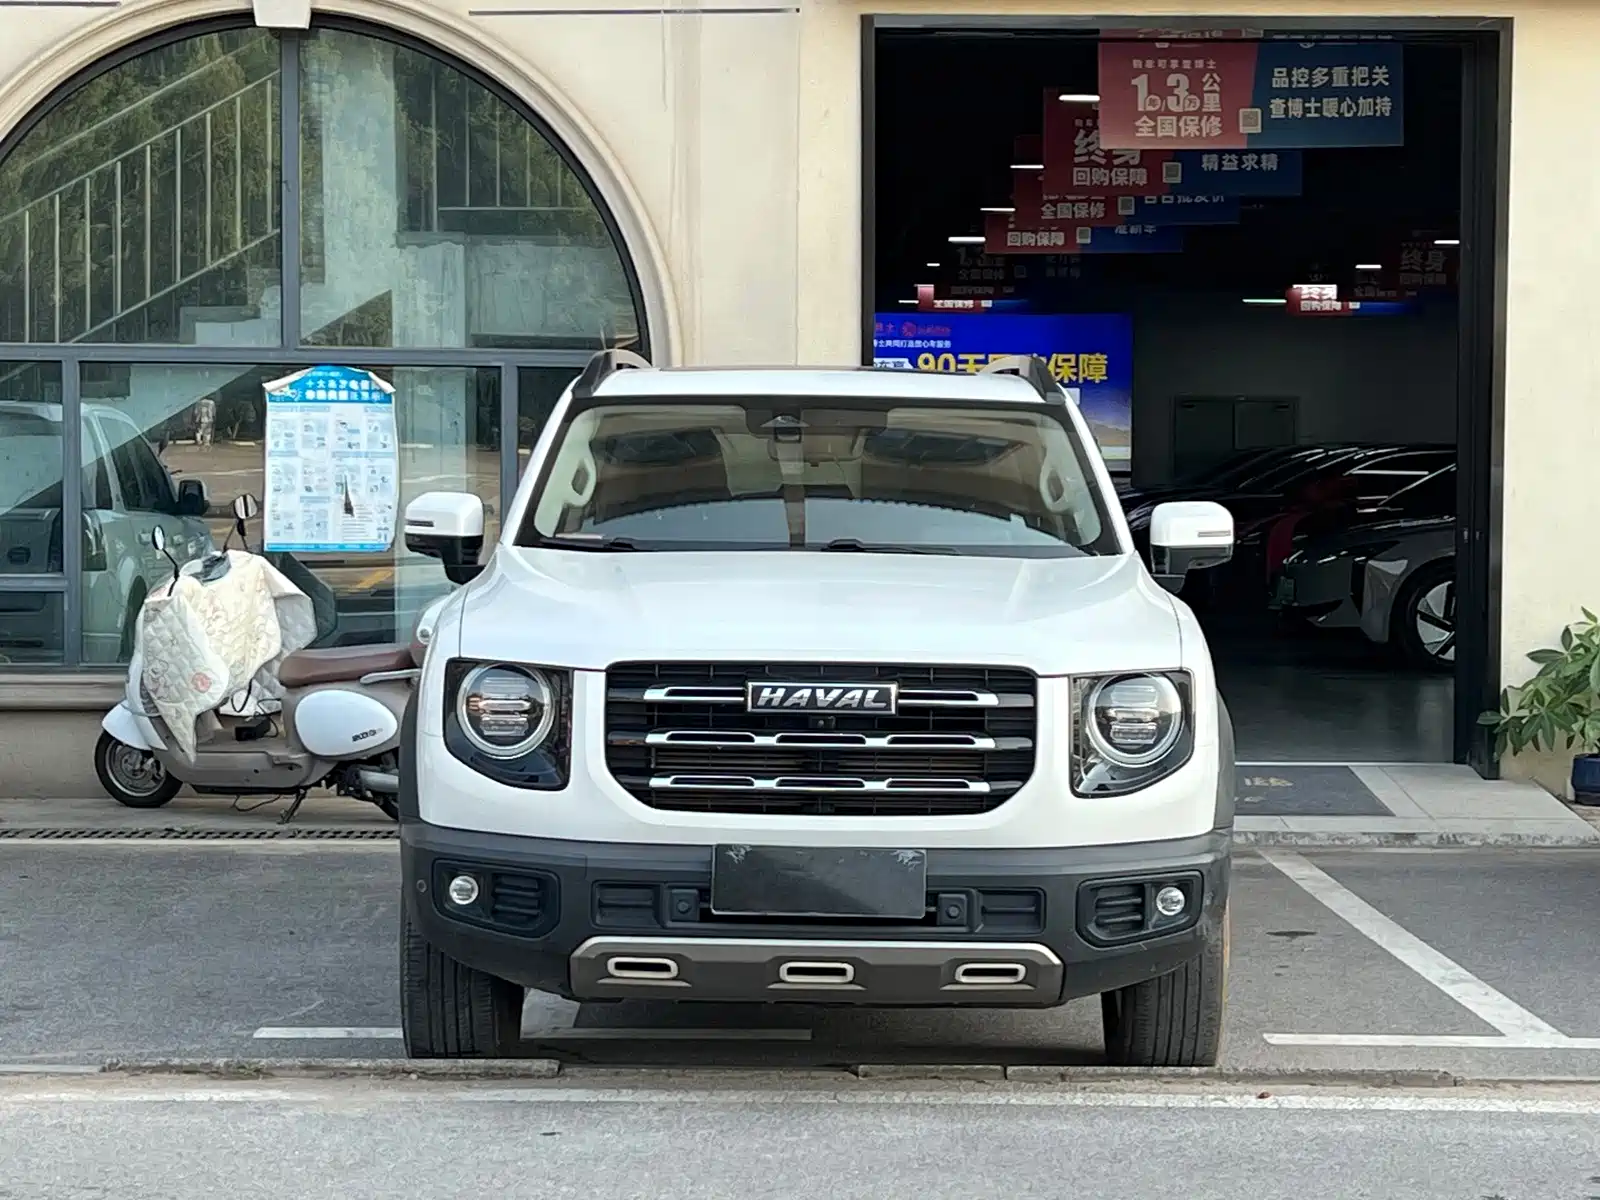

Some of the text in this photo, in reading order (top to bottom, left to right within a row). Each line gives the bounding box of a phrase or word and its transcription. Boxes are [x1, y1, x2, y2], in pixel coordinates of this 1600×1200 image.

[1271, 66, 1390, 88] 品控多重把关
[1269, 97, 1392, 119] 查博士暖心加持
[1134, 115, 1223, 137] 全国保修
[1201, 154, 1278, 171] 精益求精
[1072, 167, 1148, 186] 回购保障
[1041, 203, 1106, 219] 全国保修
[757, 687, 887, 708] HAVAL
